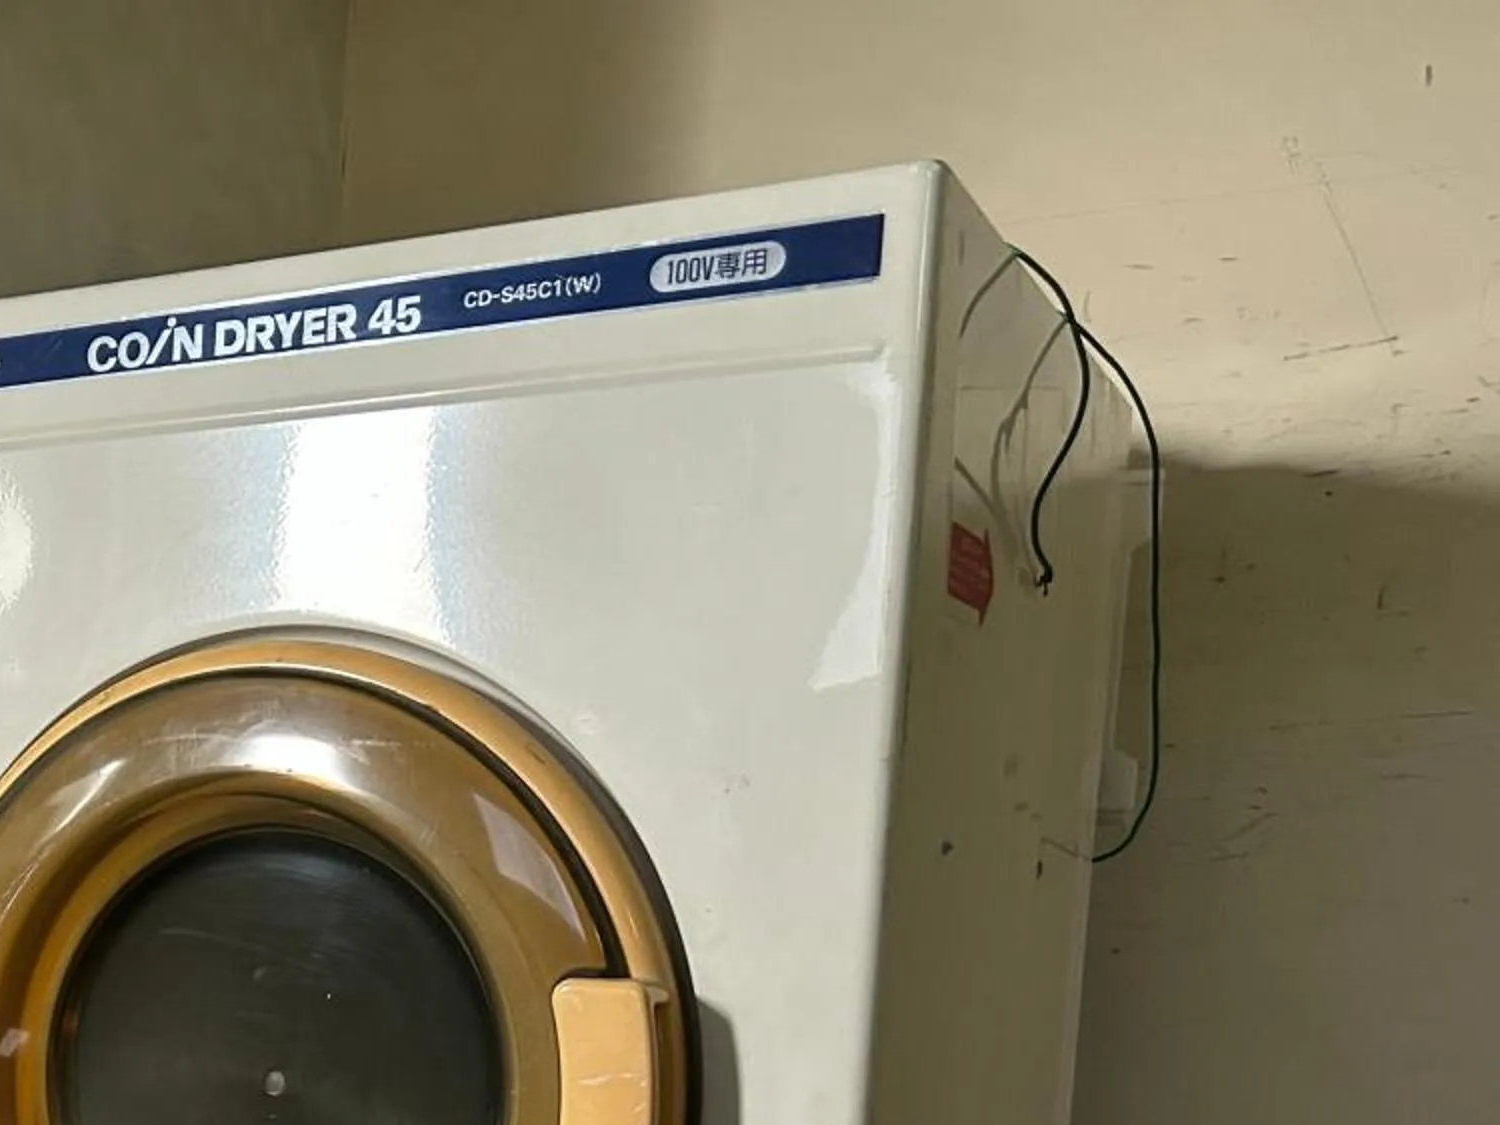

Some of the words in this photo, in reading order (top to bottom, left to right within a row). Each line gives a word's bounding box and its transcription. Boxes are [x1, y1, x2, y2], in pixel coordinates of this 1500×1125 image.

[666, 246, 769, 286] 100V専用
[463, 272, 601, 310] CD-S45C1(W)
[213, 303, 358, 357] DRYER
[367, 295, 422, 336] 45
